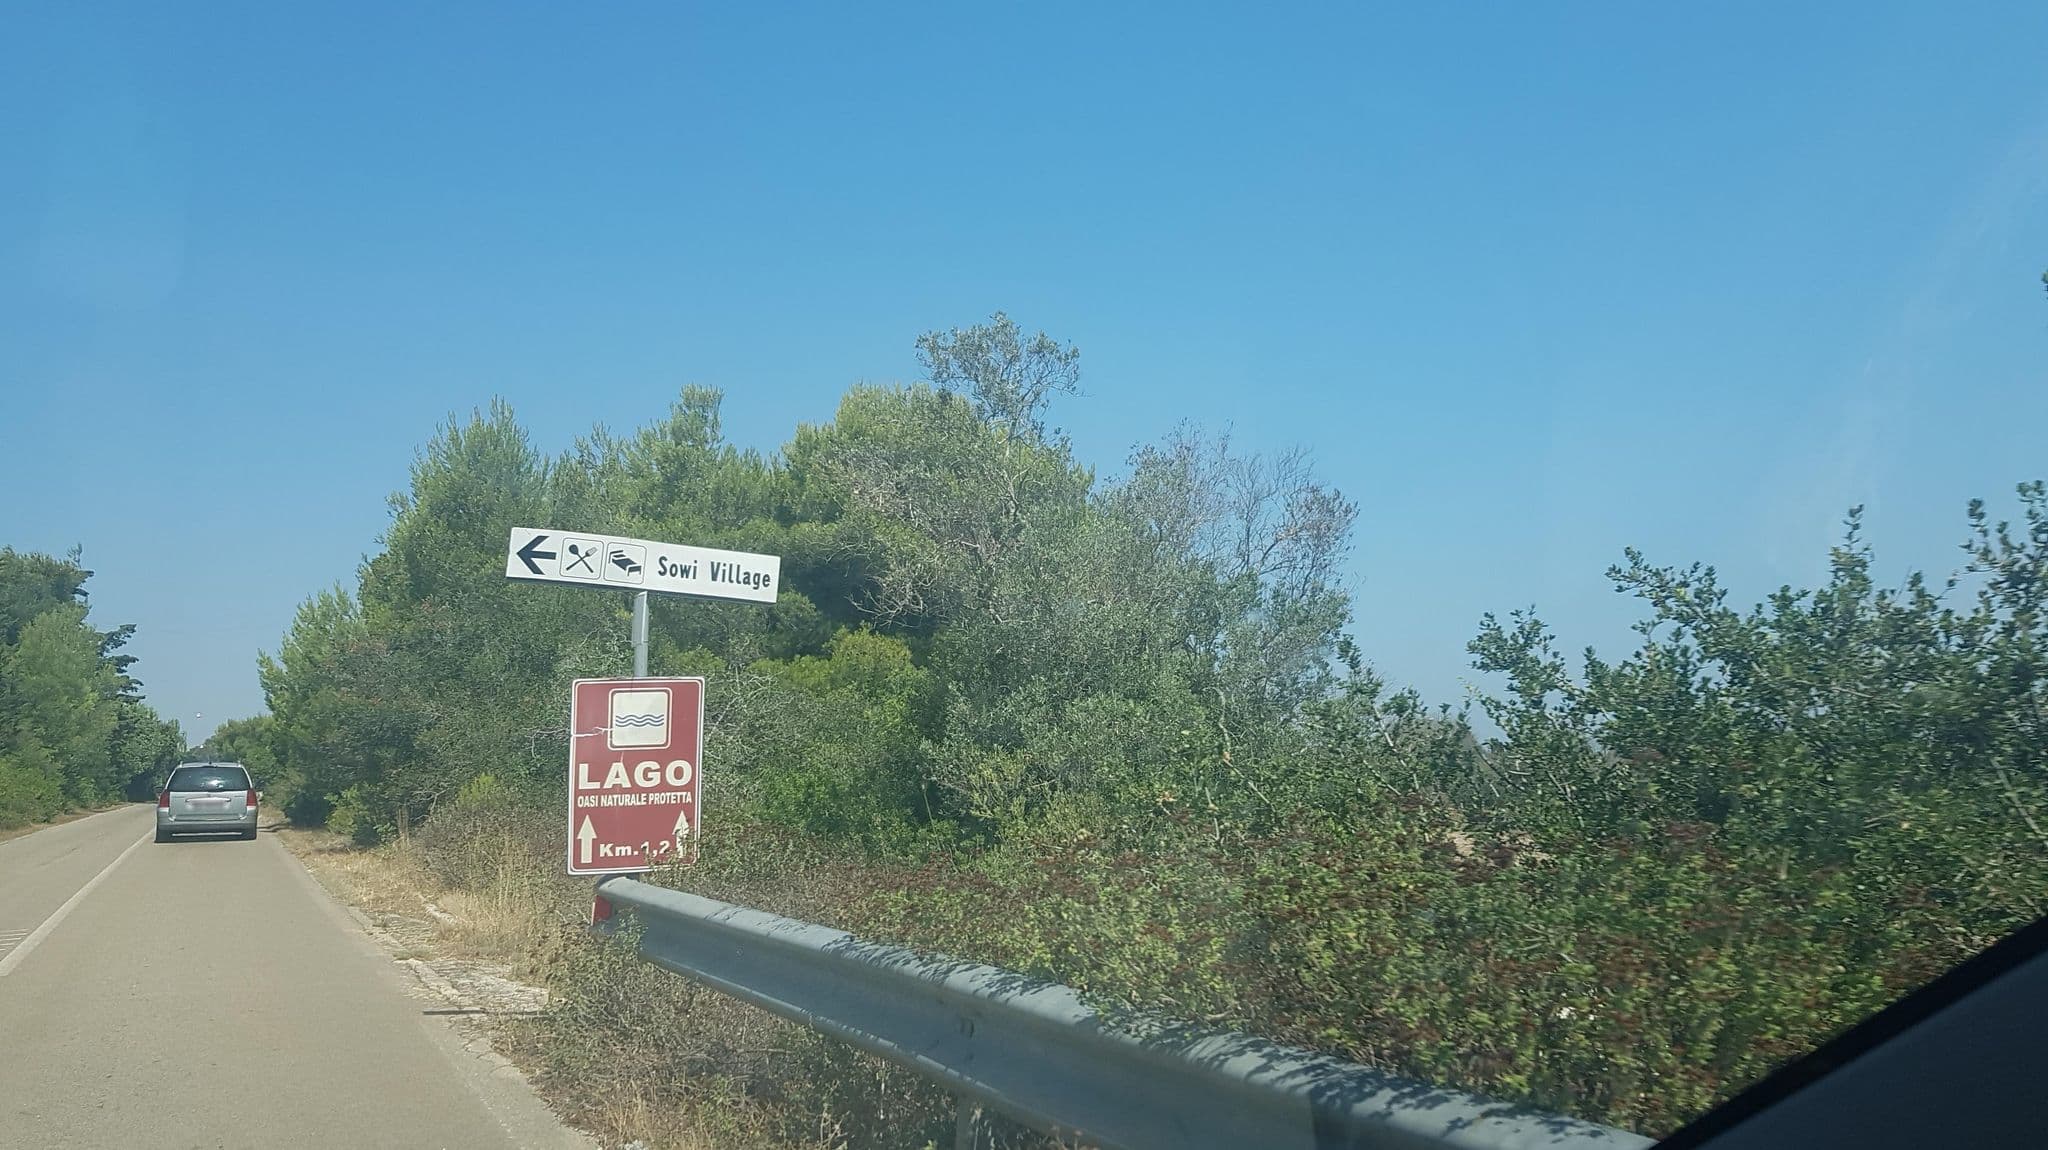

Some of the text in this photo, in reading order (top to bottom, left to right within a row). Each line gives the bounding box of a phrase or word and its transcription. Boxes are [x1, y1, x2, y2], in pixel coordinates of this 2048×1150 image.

[658, 556, 771, 590] Sowi Village
[578, 760, 692, 790] LAGO
[577, 791, 692, 808] OASI NATURALE PROTETTA
